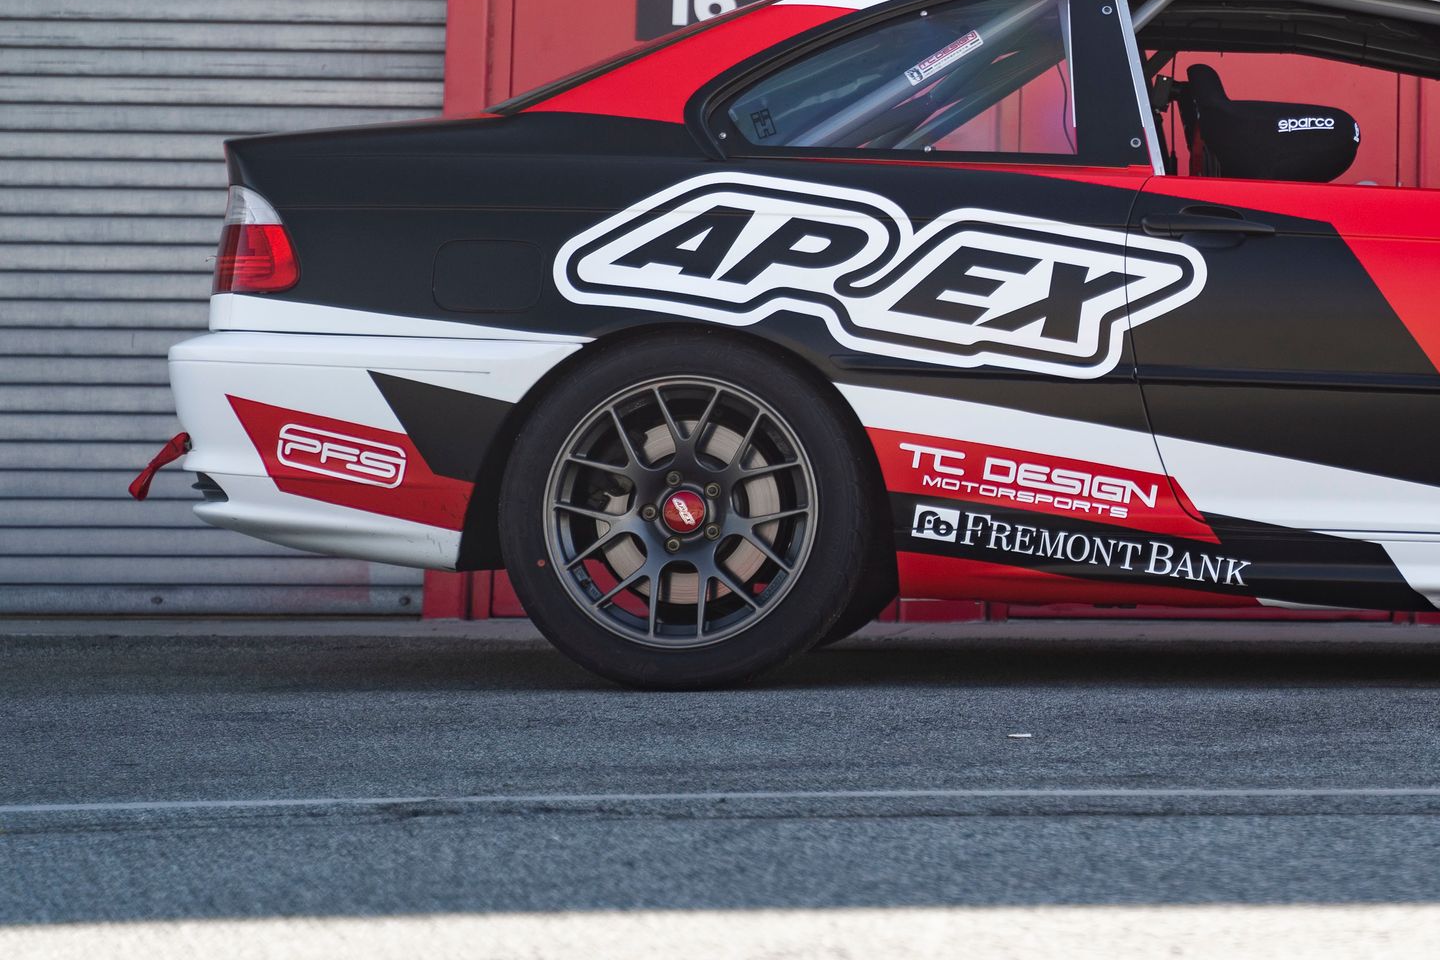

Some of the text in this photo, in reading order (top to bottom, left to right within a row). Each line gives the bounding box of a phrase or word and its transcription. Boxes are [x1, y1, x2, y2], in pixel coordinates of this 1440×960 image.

[1277, 117, 1335, 133] sparco
[611, 204, 1153, 345] APEX
[280, 433, 404, 479] PFS
[899, 442, 1159, 509] TC DESIGN
[922, 474, 1129, 519] MOTORSPORTS
[959, 511, 1143, 572] FREMONT
[1144, 540, 1252, 588] BANK
